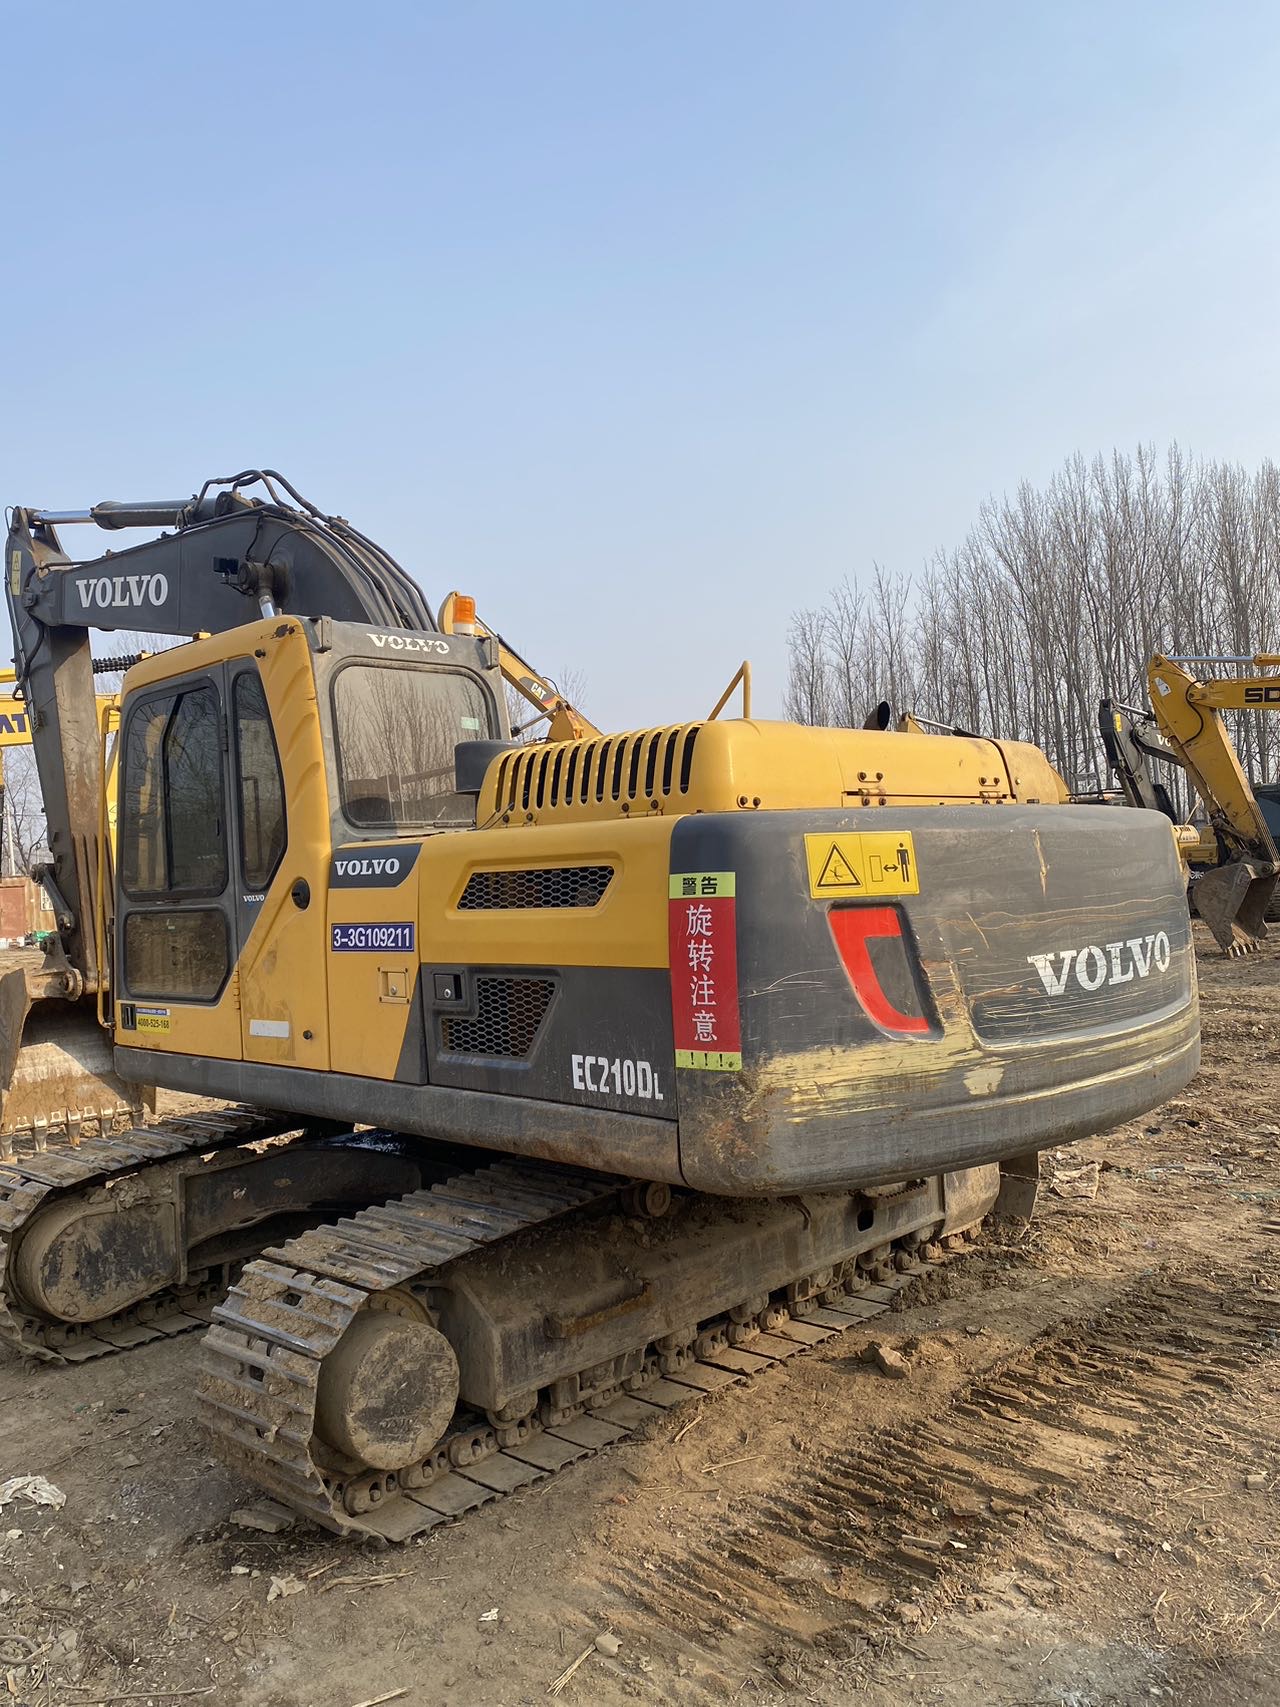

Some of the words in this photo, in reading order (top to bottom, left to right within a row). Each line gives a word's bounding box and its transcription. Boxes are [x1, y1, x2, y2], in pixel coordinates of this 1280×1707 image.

[75, 573, 168, 608] VOLVO
[366, 632, 450, 655] VOLVO
[530, 682, 547, 700] CAT
[334, 857, 400, 876] VOLVO
[682, 876, 718, 896] 警告
[243, 894, 265, 902] VOLVO
[333, 926, 410, 947] 3-3G109211
[685, 903, 718, 1042] 旋转注意
[1026, 930, 1171, 996] VOLVO
